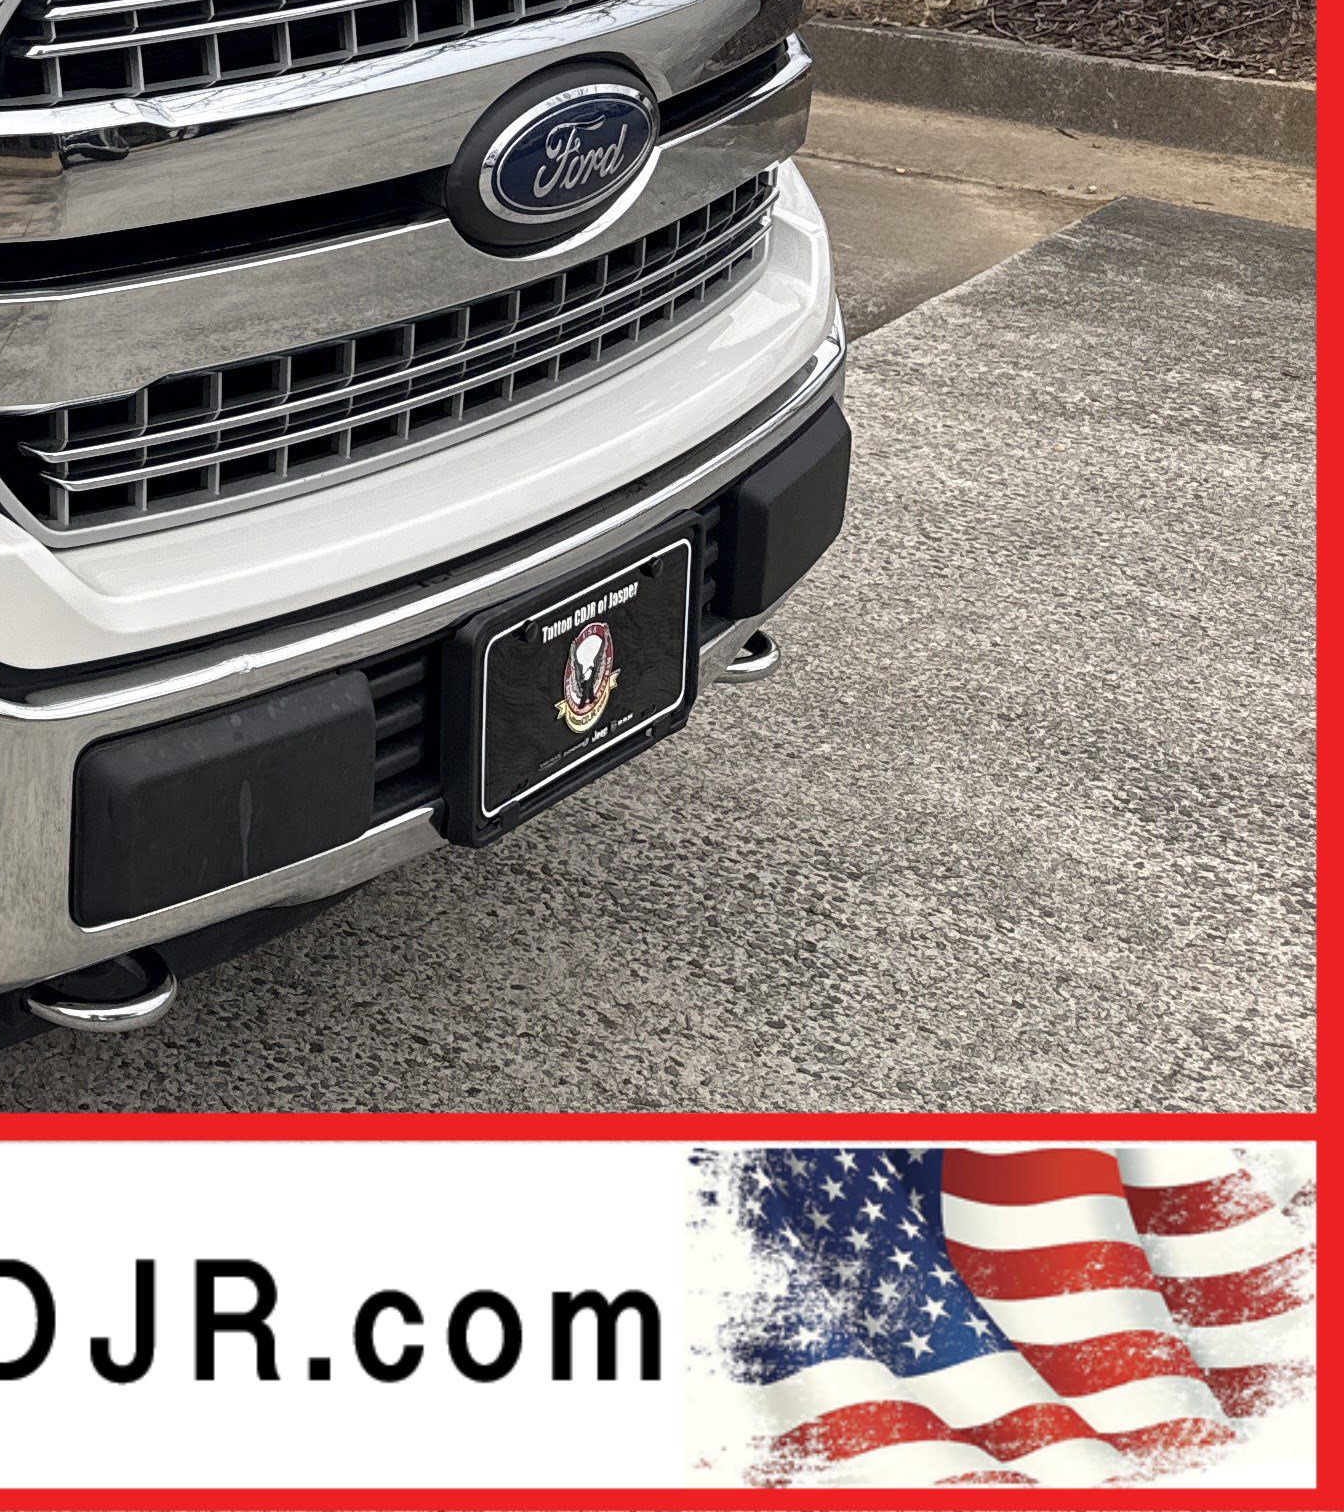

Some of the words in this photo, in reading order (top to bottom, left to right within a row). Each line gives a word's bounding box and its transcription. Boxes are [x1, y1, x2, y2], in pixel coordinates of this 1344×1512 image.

[533, 114, 628, 198] Ford
[541, 615, 573, 644] Tutton
[574, 601, 596, 627] CDJR
[598, 599, 607, 614] of
[608, 581, 639, 610] Jasper
